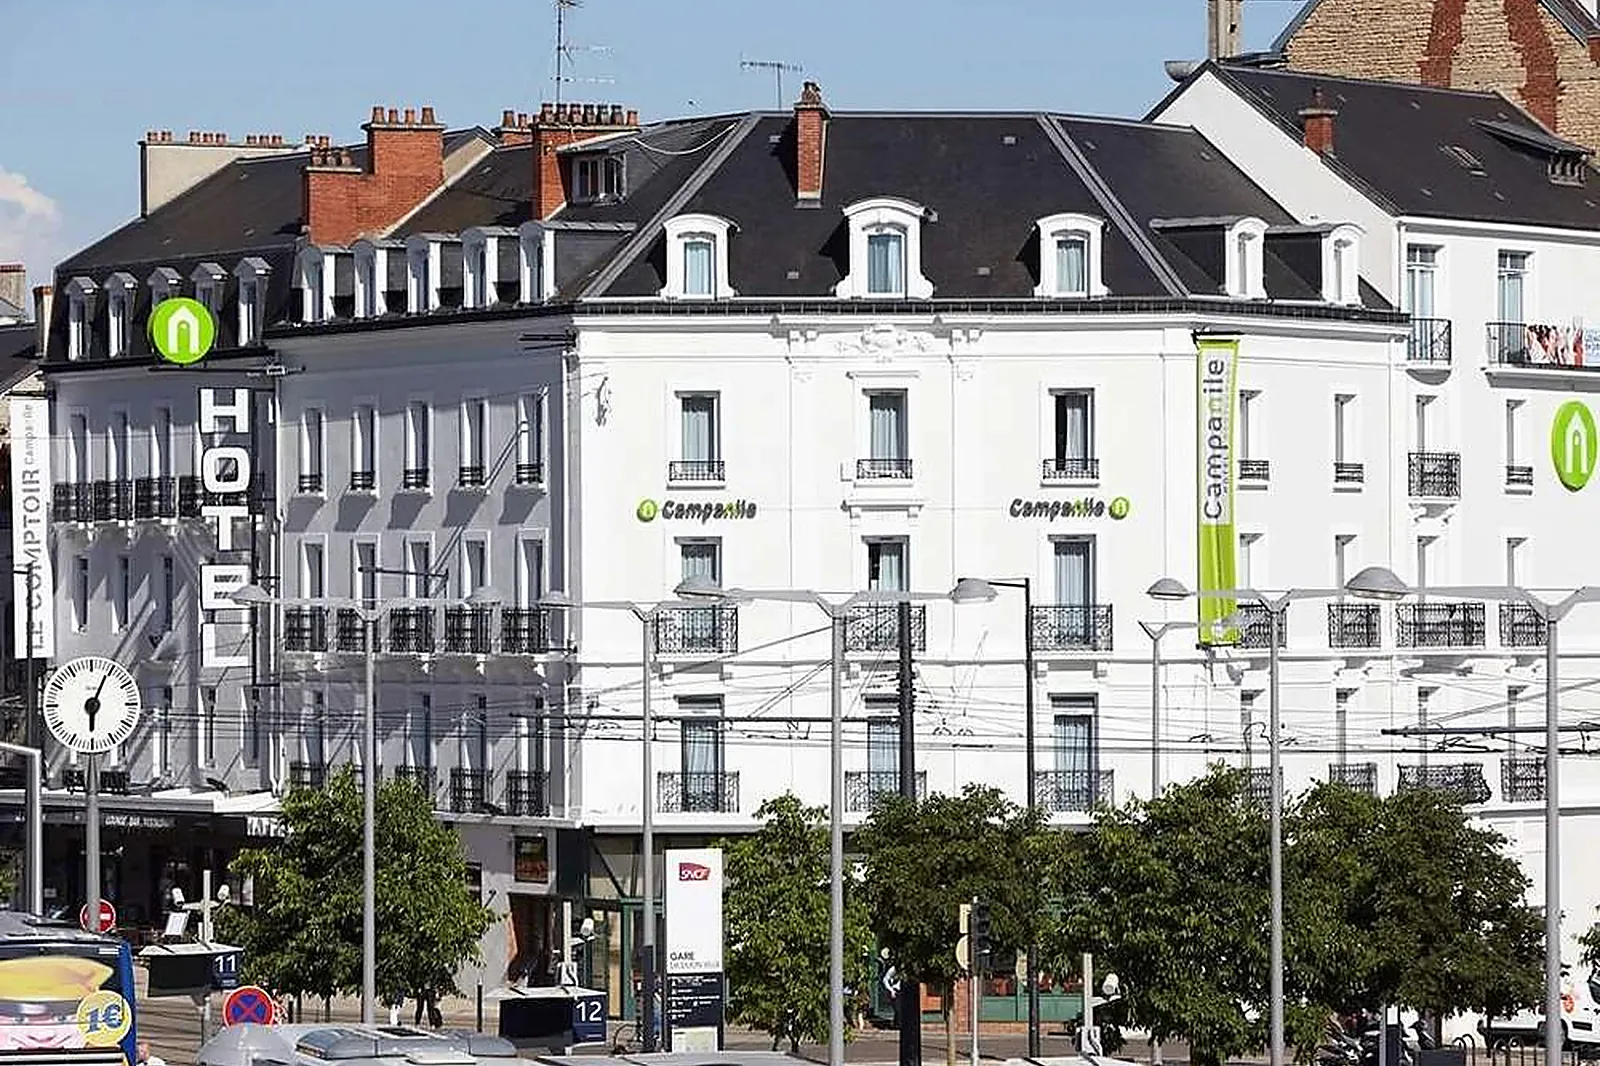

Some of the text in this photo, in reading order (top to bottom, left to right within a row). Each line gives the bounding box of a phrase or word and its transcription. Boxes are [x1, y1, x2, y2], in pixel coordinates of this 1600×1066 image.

[1203, 359, 1228, 519] Campanile
[662, 499, 755, 525] Campanile
[1009, 497, 1105, 522] Campanile
[22, 469, 43, 609] COMPTOIR
[200, 387, 250, 667] HOTEL
[214, 954, 236, 973] 11
[669, 951, 695, 961] GARE
[87, 1003, 122, 1033] 1€
[576, 1001, 602, 1022] 12
